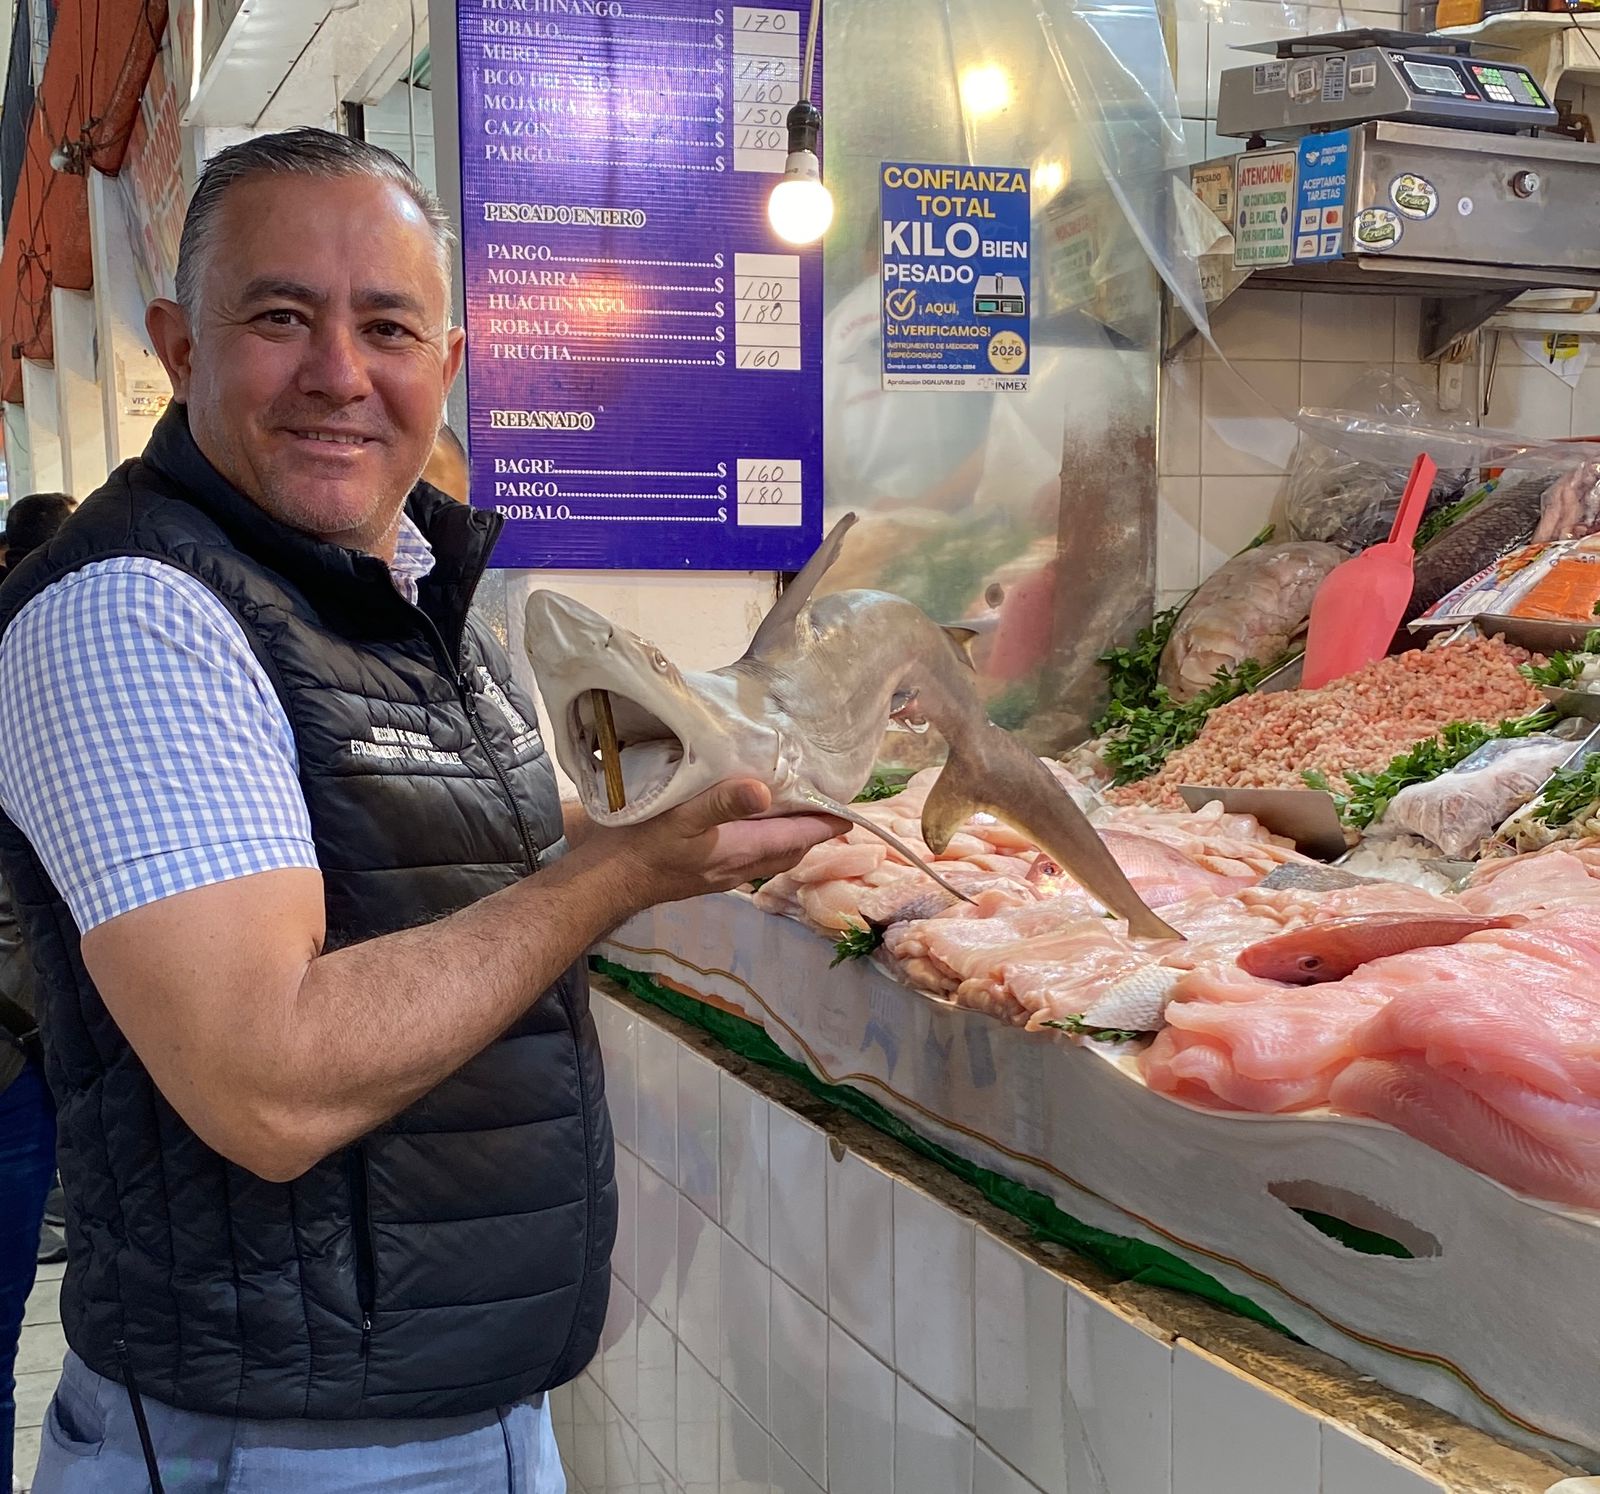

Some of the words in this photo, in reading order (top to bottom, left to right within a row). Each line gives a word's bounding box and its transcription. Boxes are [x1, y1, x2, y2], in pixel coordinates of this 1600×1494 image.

[482, 0, 622, 17] HUACHINANGO
[714, 9, 724, 25] $
[743, 14, 786, 31] 170
[481, 18, 559, 37] ROBALO
[714, 34, 724, 50] $
[482, 44, 539, 62] MERO
[740, 60, 786, 79] 170
[741, 84, 783, 103] 160
[484, 94, 577, 115] MOJARRA
[741, 108, 782, 126] 150
[714, 131, 725, 148] $
[740, 130, 780, 149] 180
[485, 144, 552, 162] PARGO
[715, 156, 725, 172] $
[884, 166, 1027, 193] CONFIANZA
[1303, 175, 1346, 190] ACEPTAMOS
[916, 195, 996, 218] TOTAL
[1307, 188, 1341, 202] TARJETAS
[484, 202, 570, 225] PESCADO
[571, 207, 646, 228] ENTERO
[883, 220, 980, 259] KILO
[981, 240, 1028, 259] BIEN
[487, 243, 551, 261] PARGO
[714, 252, 724, 269] $
[488, 268, 580, 287] MOJARRA
[714, 277, 724, 293] $
[743, 281, 783, 300] 100
[884, 264, 974, 284] PESADO
[488, 294, 625, 313] HUACHINANGO
[715, 301, 724, 318] $
[743, 302, 783, 323] 180
[489, 319, 569, 336] ROBALO
[715, 325, 725, 342] $
[901, 324, 991, 338] VERIFICAMOS!
[490, 343, 573, 361] TRUCHA
[715, 350, 725, 367] $
[740, 350, 780, 367] 160
[991, 345, 1022, 357] 2026
[995, 381, 1028, 391] INMEX
[490, 410, 595, 431] REBANADO
[494, 458, 555, 474] BAGRE
[717, 462, 727, 478] $
[746, 465, 783, 482] 160
[495, 481, 558, 497] PARGO
[717, 484, 727, 500] $
[745, 487, 783, 504] 180
[496, 504, 570, 520] ROBALO
[718, 507, 727, 523] $
